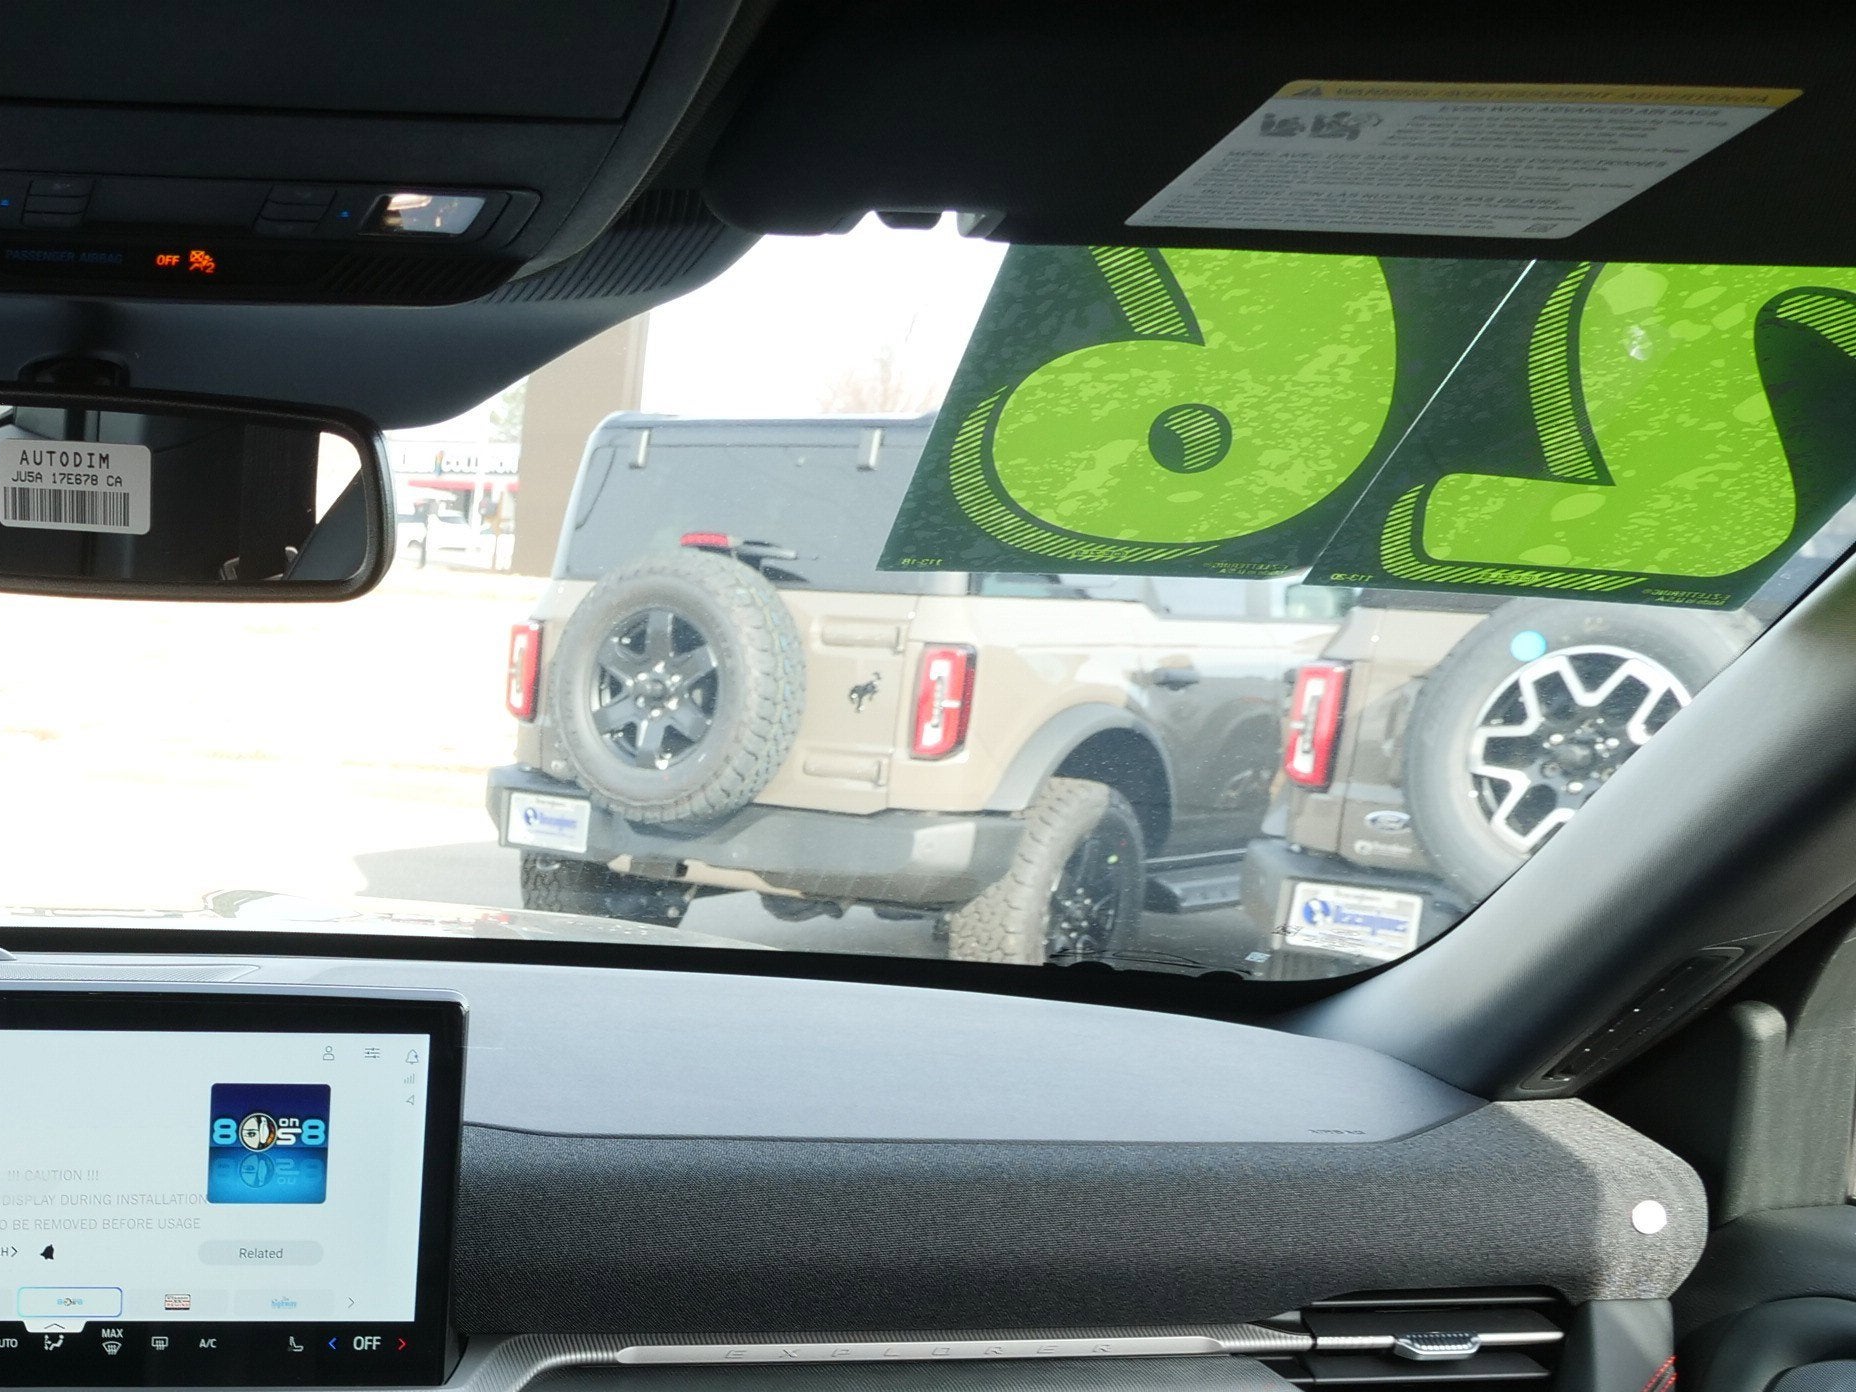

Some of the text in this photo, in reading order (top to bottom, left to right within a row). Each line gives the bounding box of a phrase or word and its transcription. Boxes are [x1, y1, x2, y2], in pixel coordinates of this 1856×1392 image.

[156, 254, 180, 267] OFF
[19, 449, 111, 469] AUTODIM
[11, 470, 123, 487] JU5A 17E678 CA
[24, 1169, 83, 1181] CAUTION
[2, 1195, 55, 1207] DISPLAY
[60, 1194, 113, 1207] DURING
[116, 1193, 208, 1206] INSTALLATION
[12, 1219, 30, 1231] BE
[34, 1219, 98, 1231] REMOVED
[102, 1218, 154, 1231] BEFORE
[157, 1218, 202, 1230] USAGE
[238, 1247, 284, 1259] Related
[101, 1328, 124, 1339] MAX
[199, 1338, 217, 1349] A/C
[353, 1336, 381, 1350] OFF
